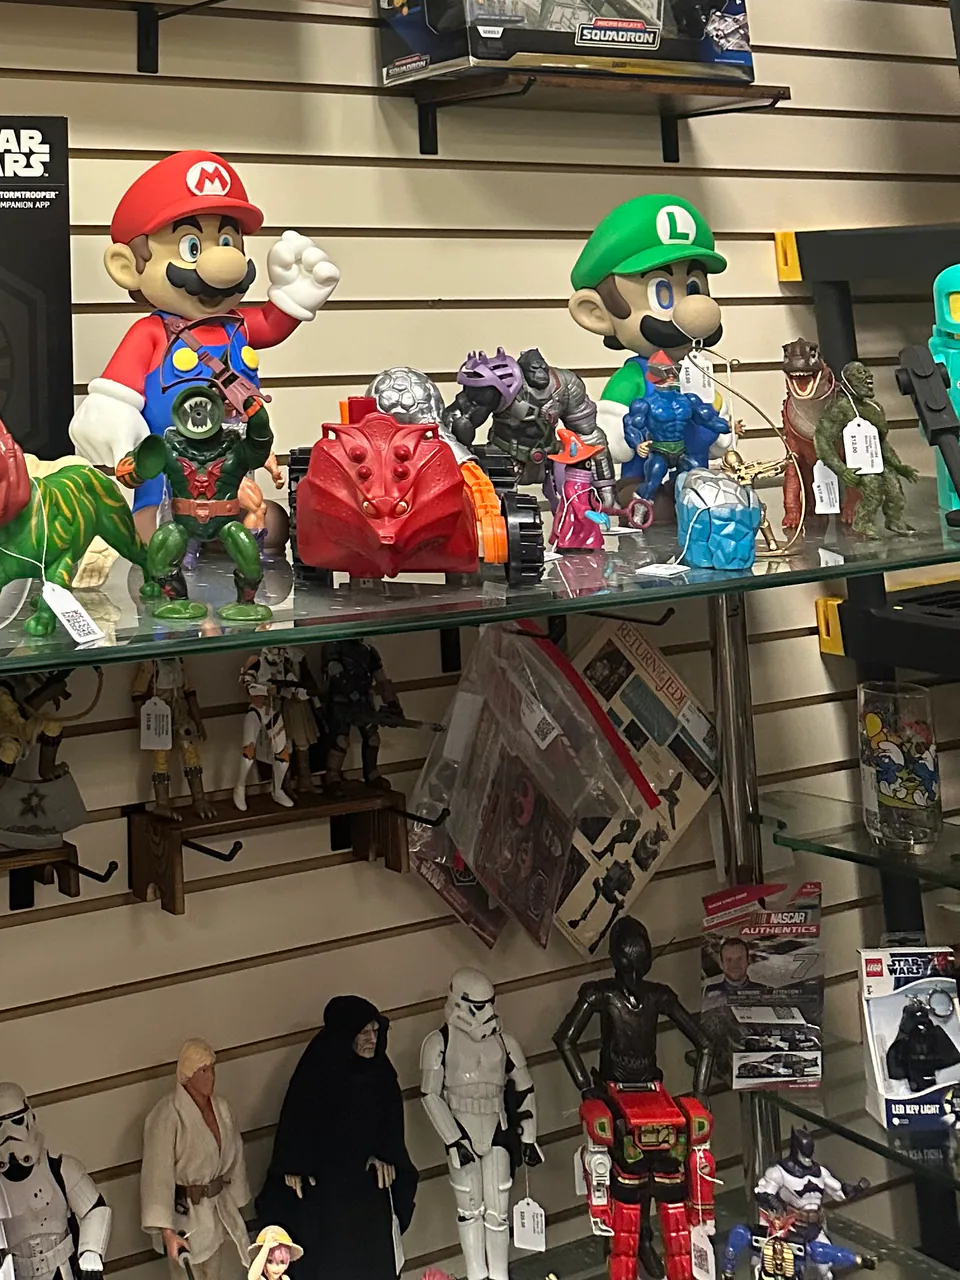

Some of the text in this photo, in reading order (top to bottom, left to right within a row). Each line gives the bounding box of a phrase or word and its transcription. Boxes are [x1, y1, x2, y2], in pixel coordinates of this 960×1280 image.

[582, 28, 654, 44] SQUADRON
[389, 59, 426, 75] SQUADRON
[194, 164, 227, 195] M
[34, 201, 50, 209] APP
[667, 209, 692, 241] L
[617, 623, 660, 673] RETURN
[655, 677, 688, 706] JEDI
[770, 912, 806, 924] NASCAR
[741, 925, 817, 935] AUTHENTICS
[790, 953, 819, 979] 7
[867, 963, 882, 972] LEGO
[887, 959, 922, 968] STAR
[888, 966, 923, 976] WARS
[892, 1104, 940, 1115] LED KEY LIGHT
